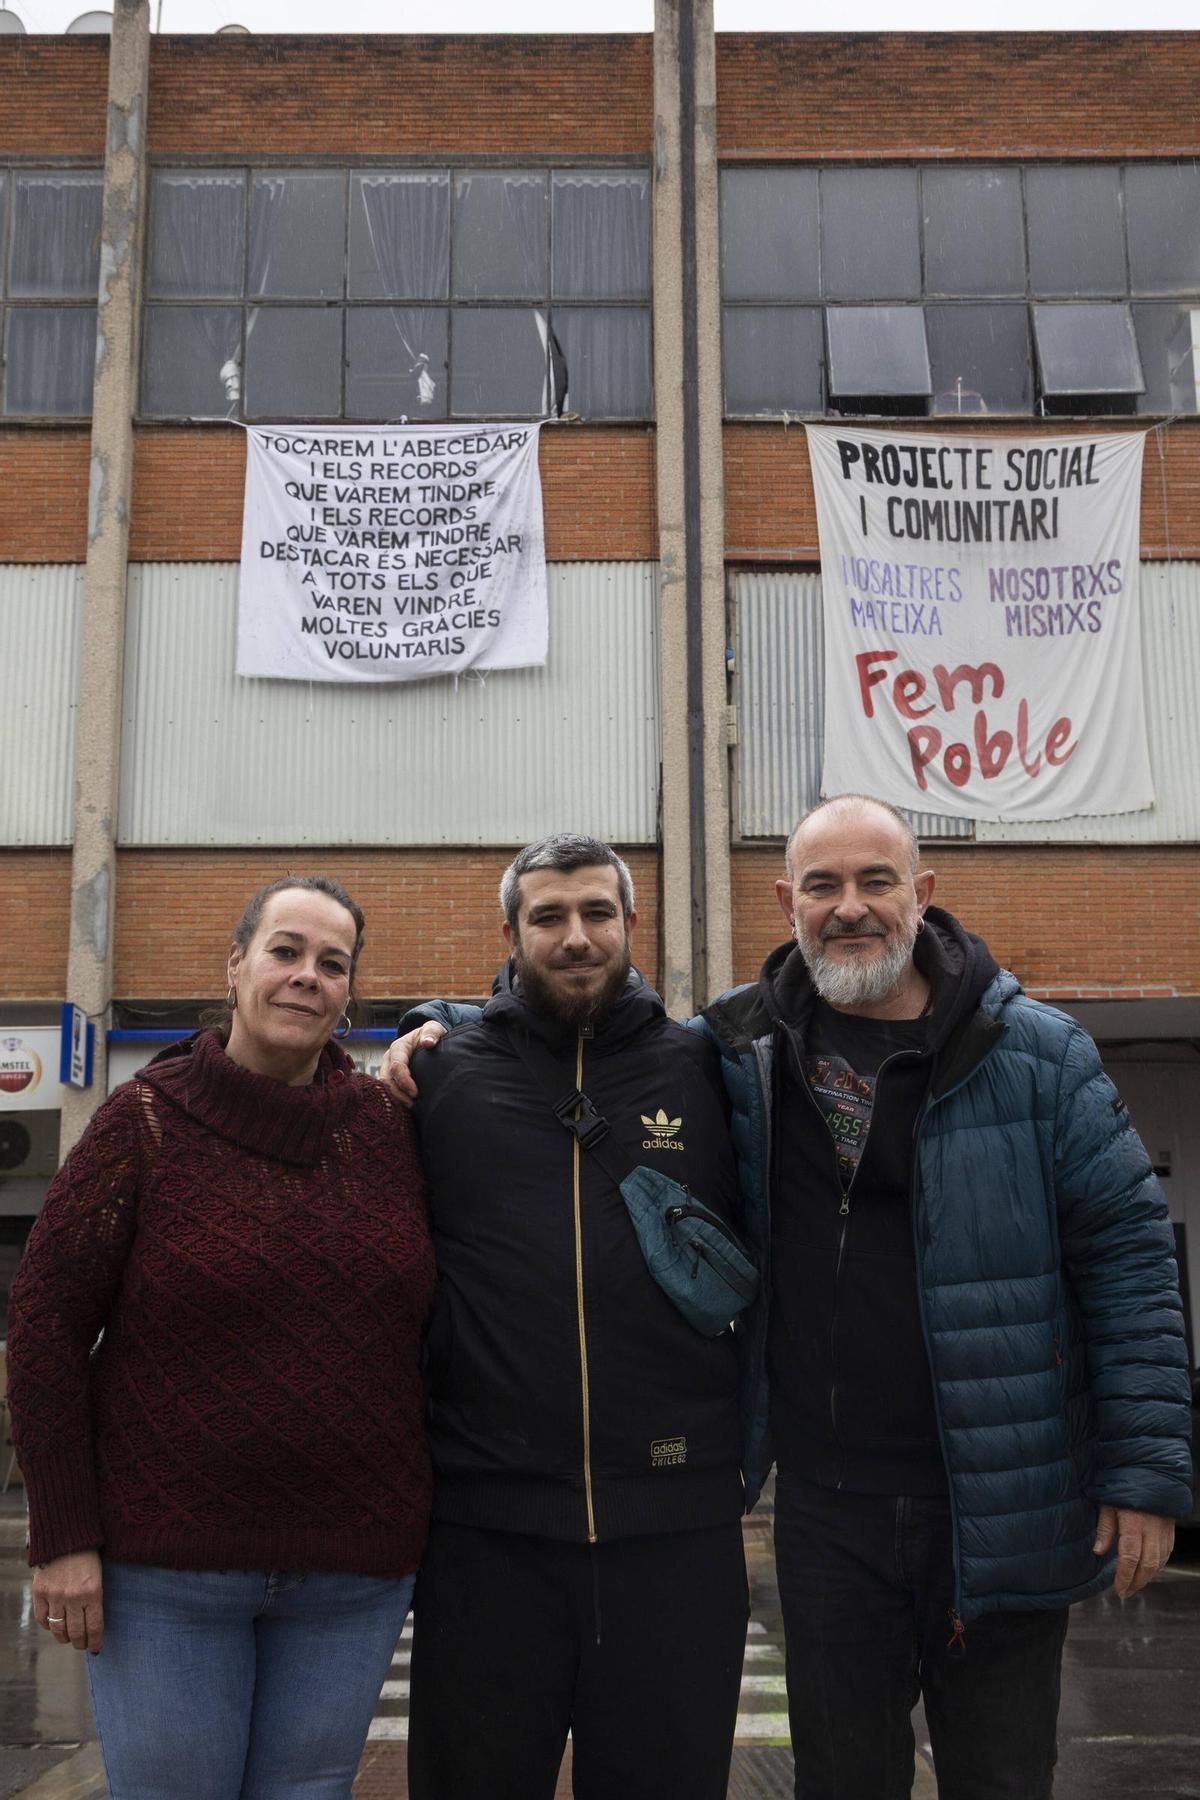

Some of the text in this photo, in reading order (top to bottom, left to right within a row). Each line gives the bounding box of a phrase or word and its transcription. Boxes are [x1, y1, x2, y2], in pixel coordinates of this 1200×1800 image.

[260, 434, 374, 457] TOCAREM
[310, 460, 477, 481] I ELS RECORDS
[836, 440, 1100, 491] PROJECTE SOCIAL
[284, 481, 328, 502] QUE
[310, 505, 477, 526] I ELS RECORDS
[859, 495, 1059, 543] I COMUNITARI
[286, 524, 327, 543] QUE
[417, 522, 491, 548] TINDRE
[260, 540, 370, 569] DESTACAR
[378, 550, 406, 570] ÉS
[302, 561, 492, 591] A TOTS ELS QUE
[842, 554, 963, 603] NOSALTRES
[988, 559, 1123, 603] NOSOTRXS
[311, 591, 382, 616] VAREN
[301, 609, 501, 638] MOLTES GRÀCIES
[850, 598, 943, 636] MATEIXA
[1005, 601, 1102, 638] MISMXS
[324, 636, 466, 660] VOLUNTARIS
[855, 650, 1006, 721] Fem
[906, 697, 1079, 792] Poble
[0, 1061, 31, 1070] MSTEL
[813, 1086, 860, 1104] DESTINATION
[836, 1103, 855, 1112] YEAR
[826, 1111, 862, 1137] 1955
[642, 1137, 685, 1151] adidas
[653, 1442, 684, 1454] adidas
